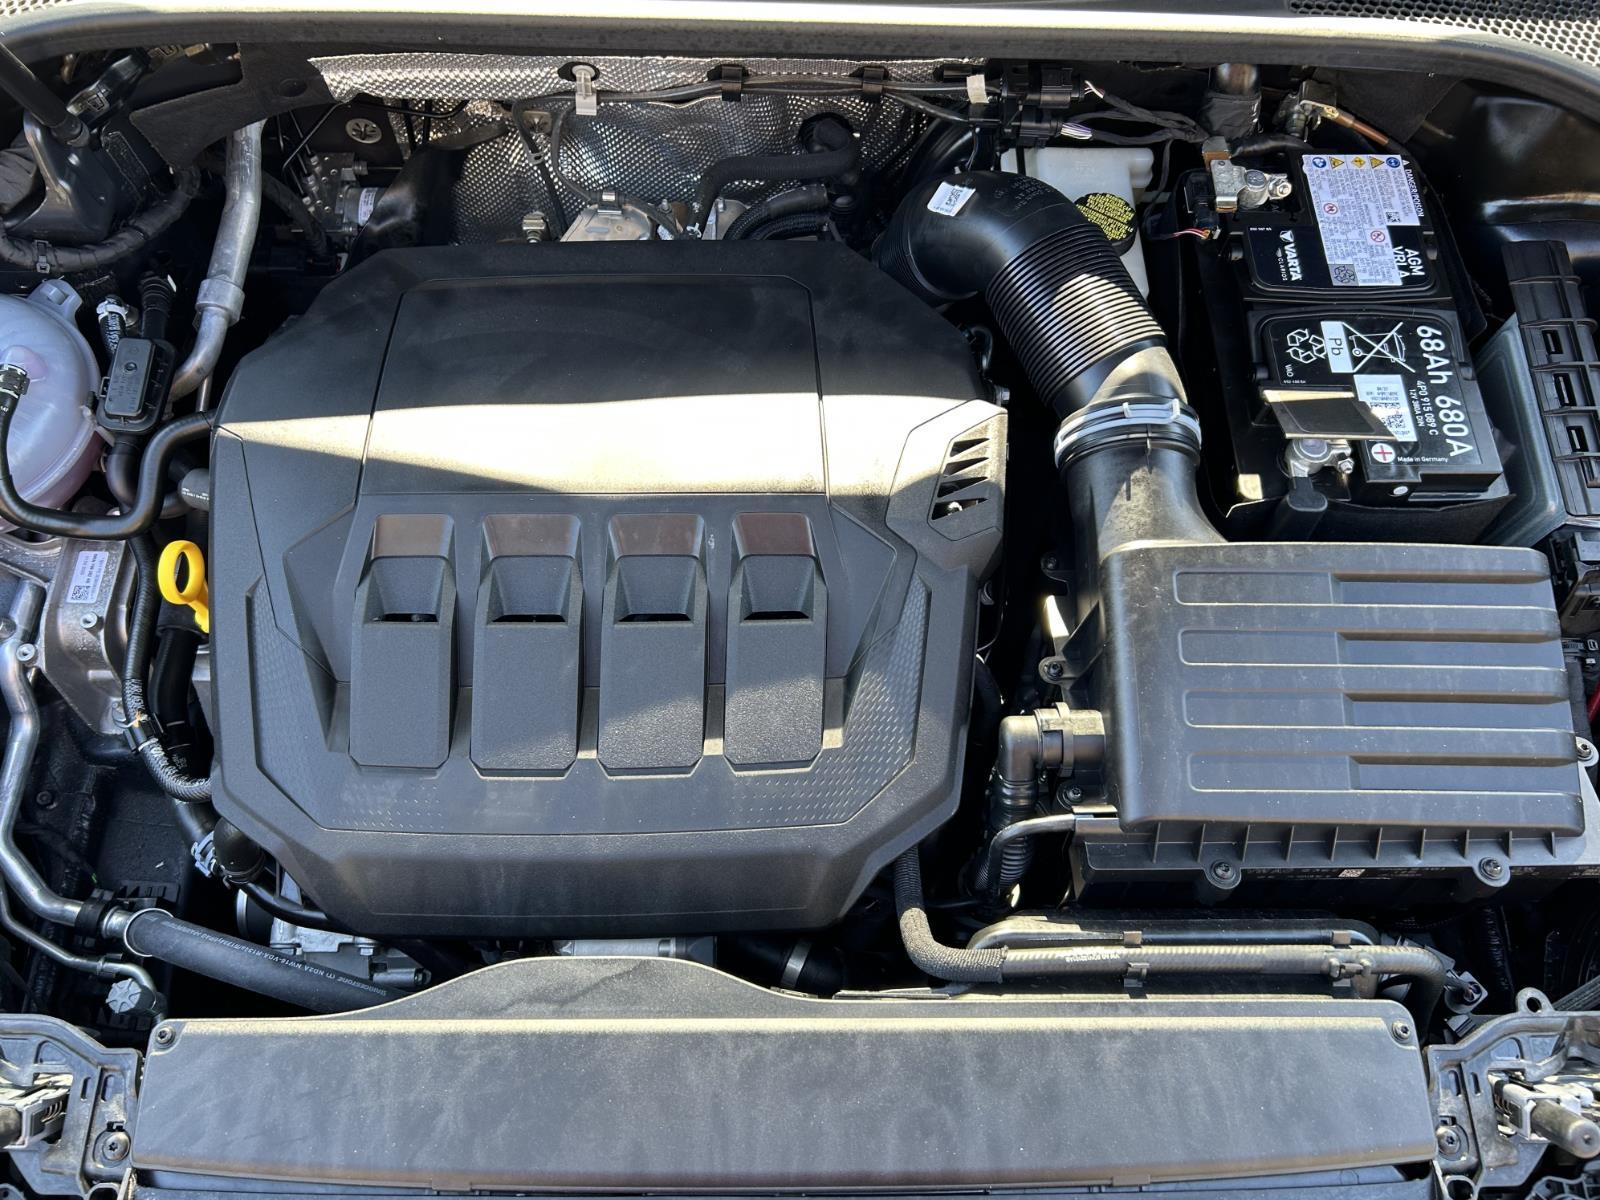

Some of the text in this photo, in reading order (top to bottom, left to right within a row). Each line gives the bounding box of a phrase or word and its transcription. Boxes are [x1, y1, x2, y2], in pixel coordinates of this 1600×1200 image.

[1405, 168, 1424, 217] DANGER/POISON
[1278, 257, 1288, 281] CLARIOS
[1285, 243, 1303, 281] VARTA
[1404, 248, 1426, 276] AGM
[1328, 337, 1344, 356] Pb
[1409, 389, 1418, 400] 12V
[1416, 324, 1474, 457] 68Ah 680A
[1421, 397, 1433, 413] 915
[1397, 455, 1449, 464] Made in Germany
